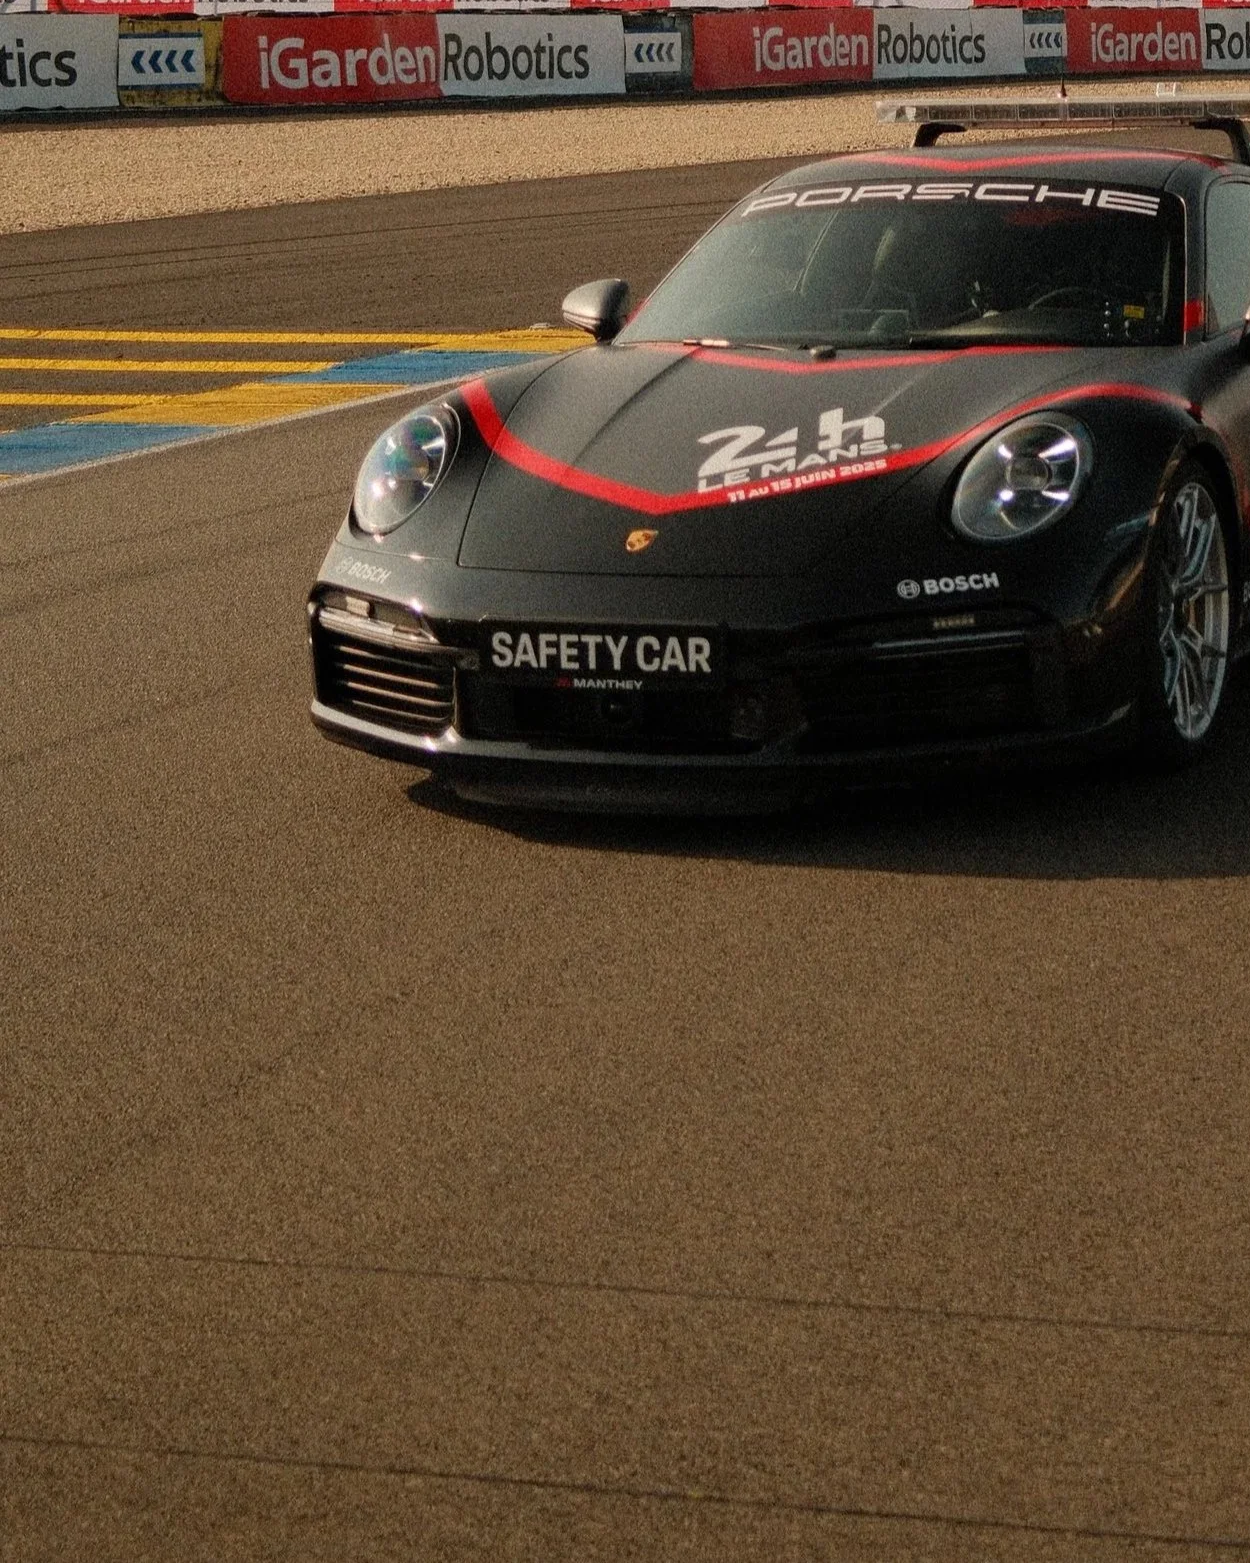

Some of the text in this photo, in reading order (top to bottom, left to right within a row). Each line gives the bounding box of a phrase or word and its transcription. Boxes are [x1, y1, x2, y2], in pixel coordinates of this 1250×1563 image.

[258, 32, 590, 89] iGarden Robotics
[753, 22, 986, 72] iGarden Robotics
[1091, 21, 1196, 63] iGarden
[741, 182, 1160, 217] PORSCHE
[698, 440, 888, 494] LE MANS
[727, 459, 887, 502] 11 AU 15 JUIN 2025
[347, 561, 392, 584] BOSCH
[923, 572, 999, 595] BOSCH
[491, 631, 712, 673] SAFETY CAR
[573, 678, 643, 690] MANTHEY
